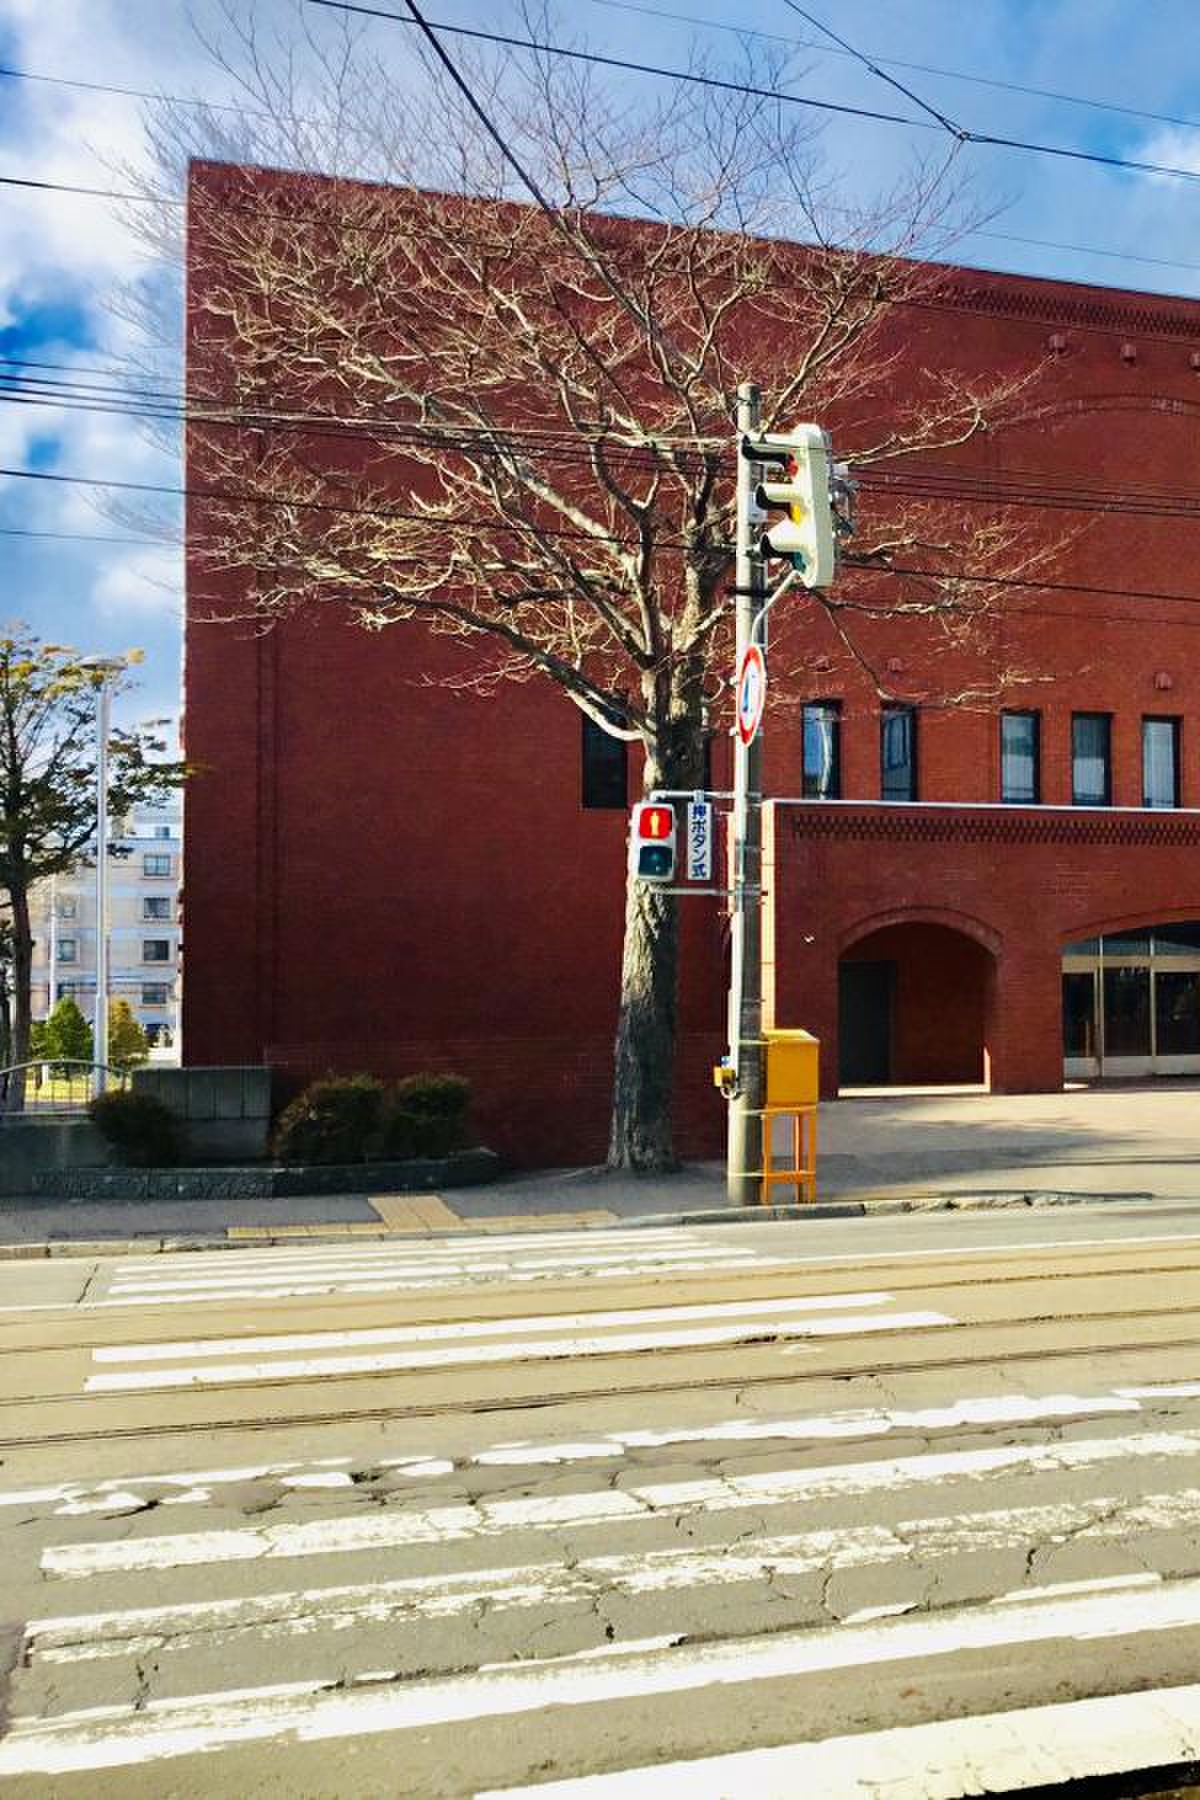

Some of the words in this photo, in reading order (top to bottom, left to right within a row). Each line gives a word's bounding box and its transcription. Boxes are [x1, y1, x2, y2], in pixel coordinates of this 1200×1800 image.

[691, 804, 707, 878] 押ボタン式
